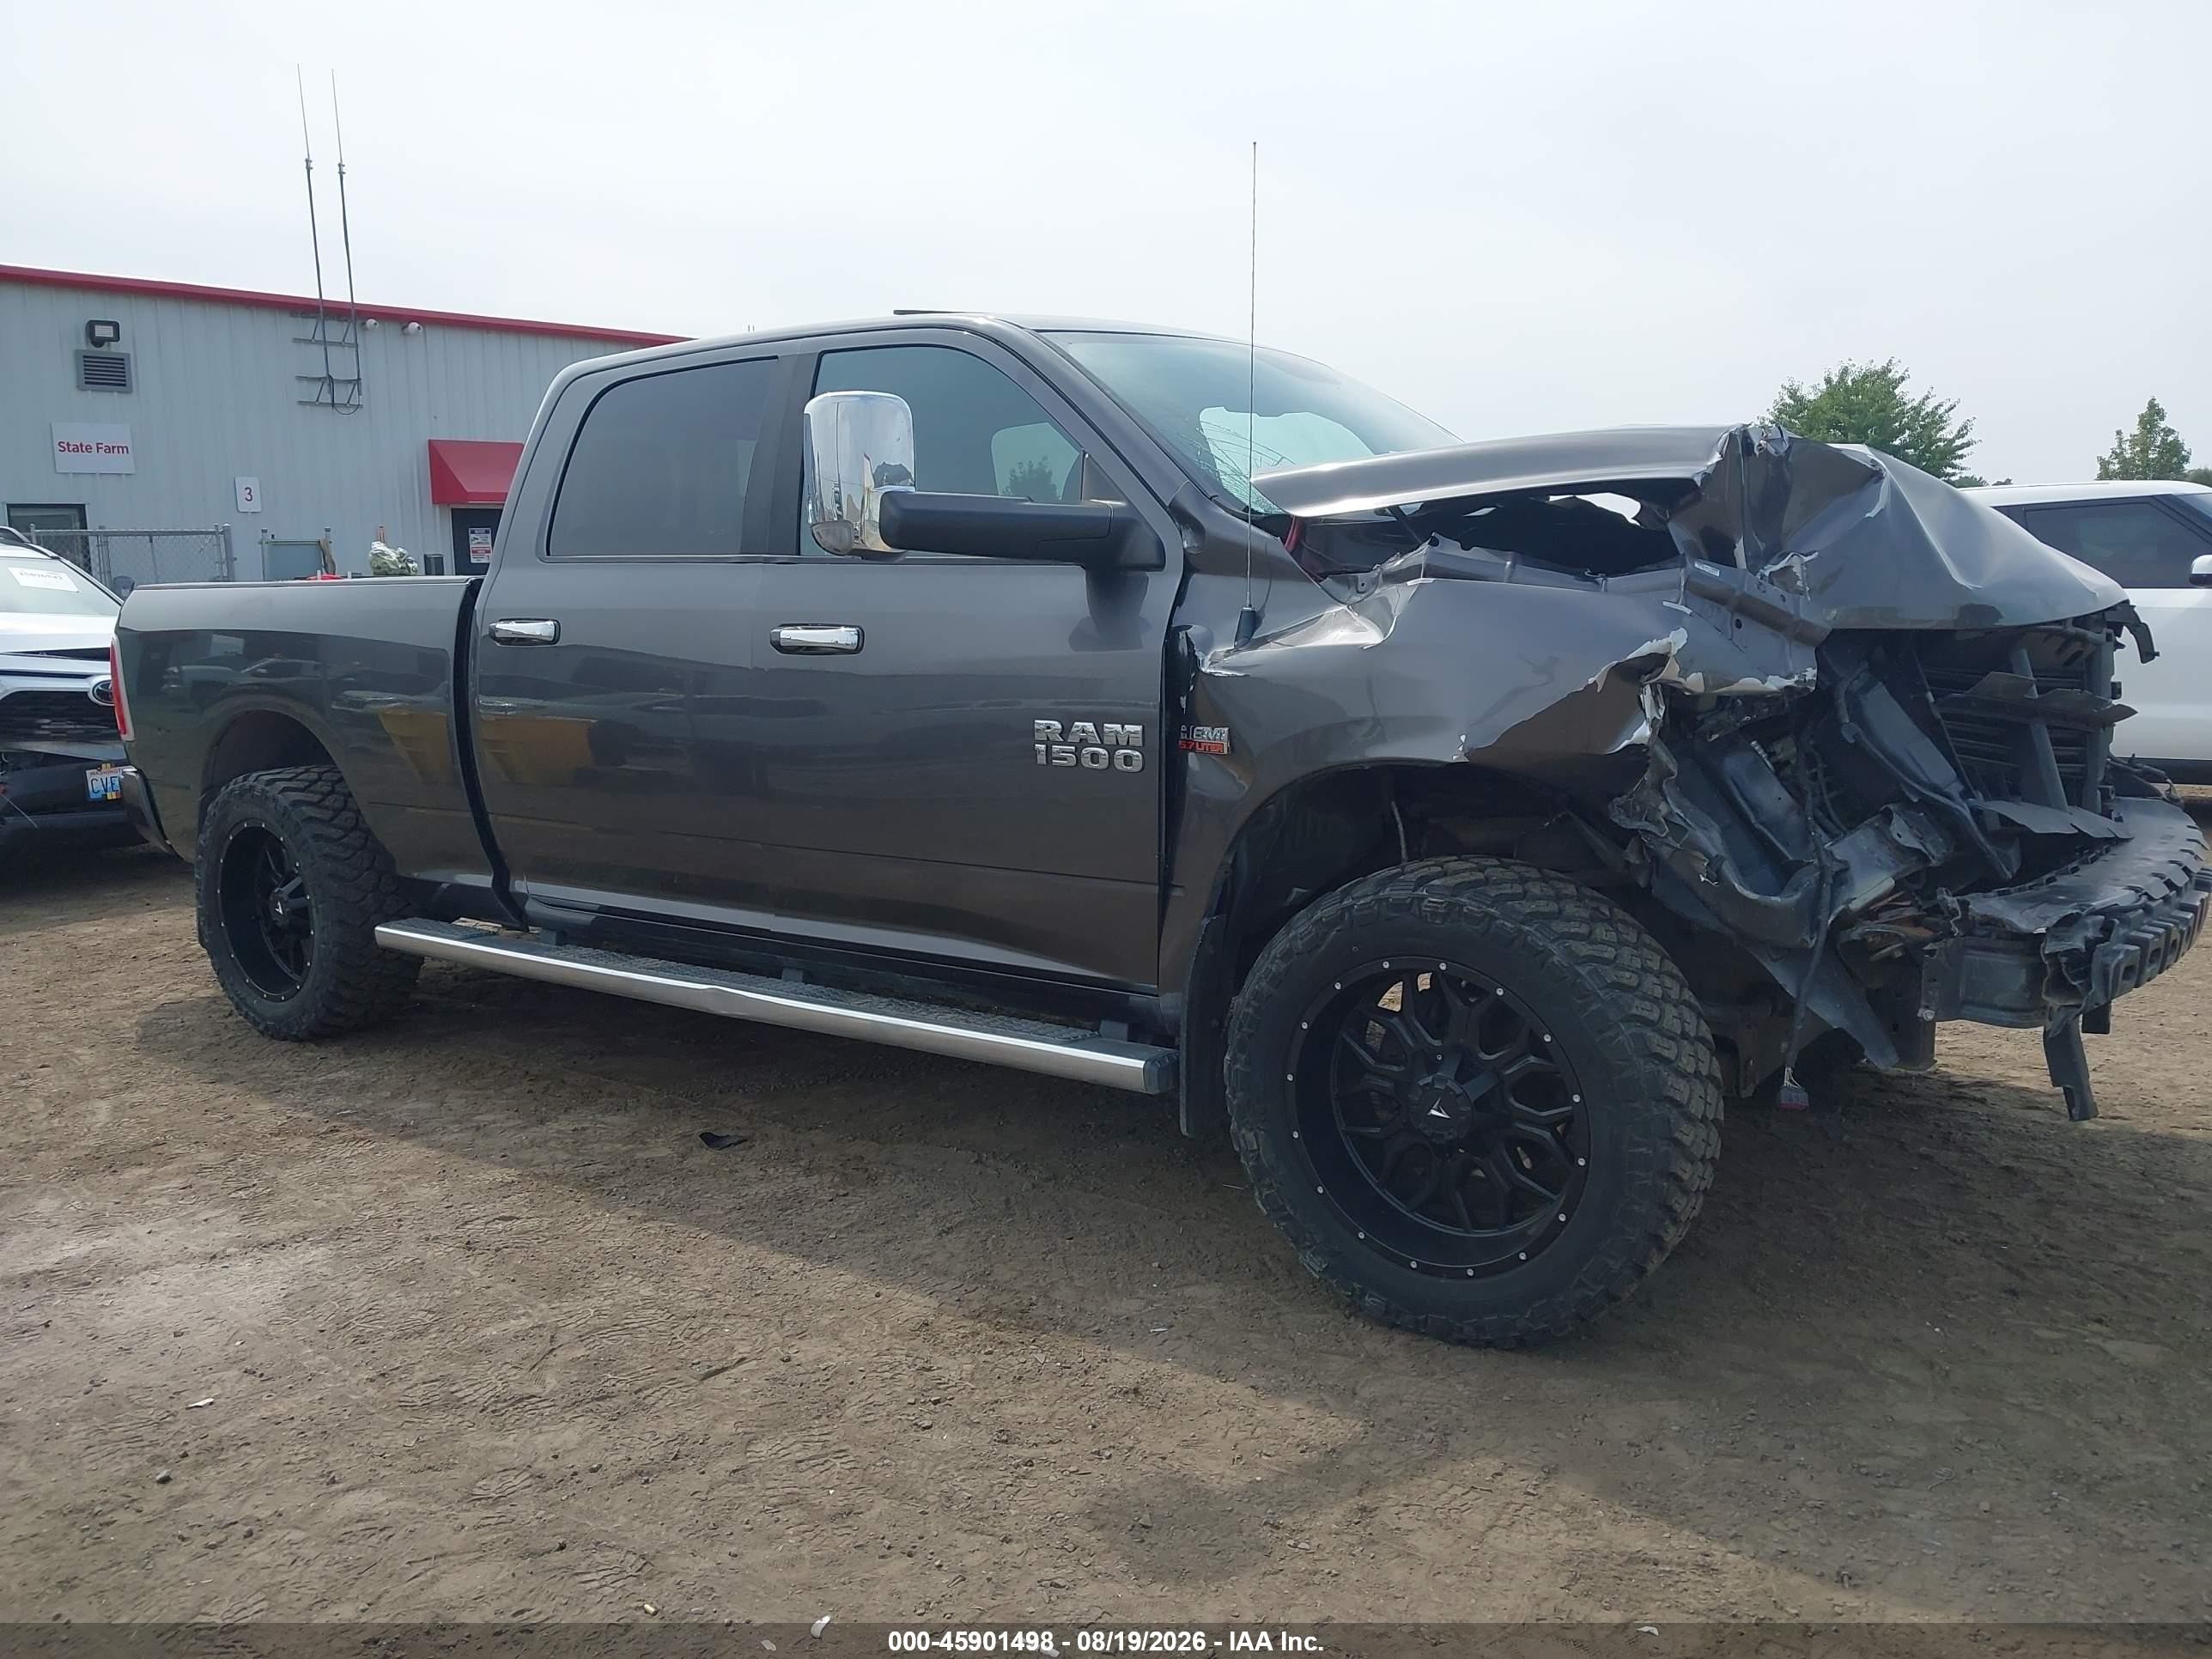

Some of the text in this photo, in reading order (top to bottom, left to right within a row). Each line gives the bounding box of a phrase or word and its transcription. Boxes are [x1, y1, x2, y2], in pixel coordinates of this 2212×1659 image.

[58, 441, 130, 454] State Farm
[244, 487, 253, 502] 3
[1033, 720, 1144, 746] RAM
[1034, 744, 1143, 773] 1500
[90, 776, 119, 794] CVE
